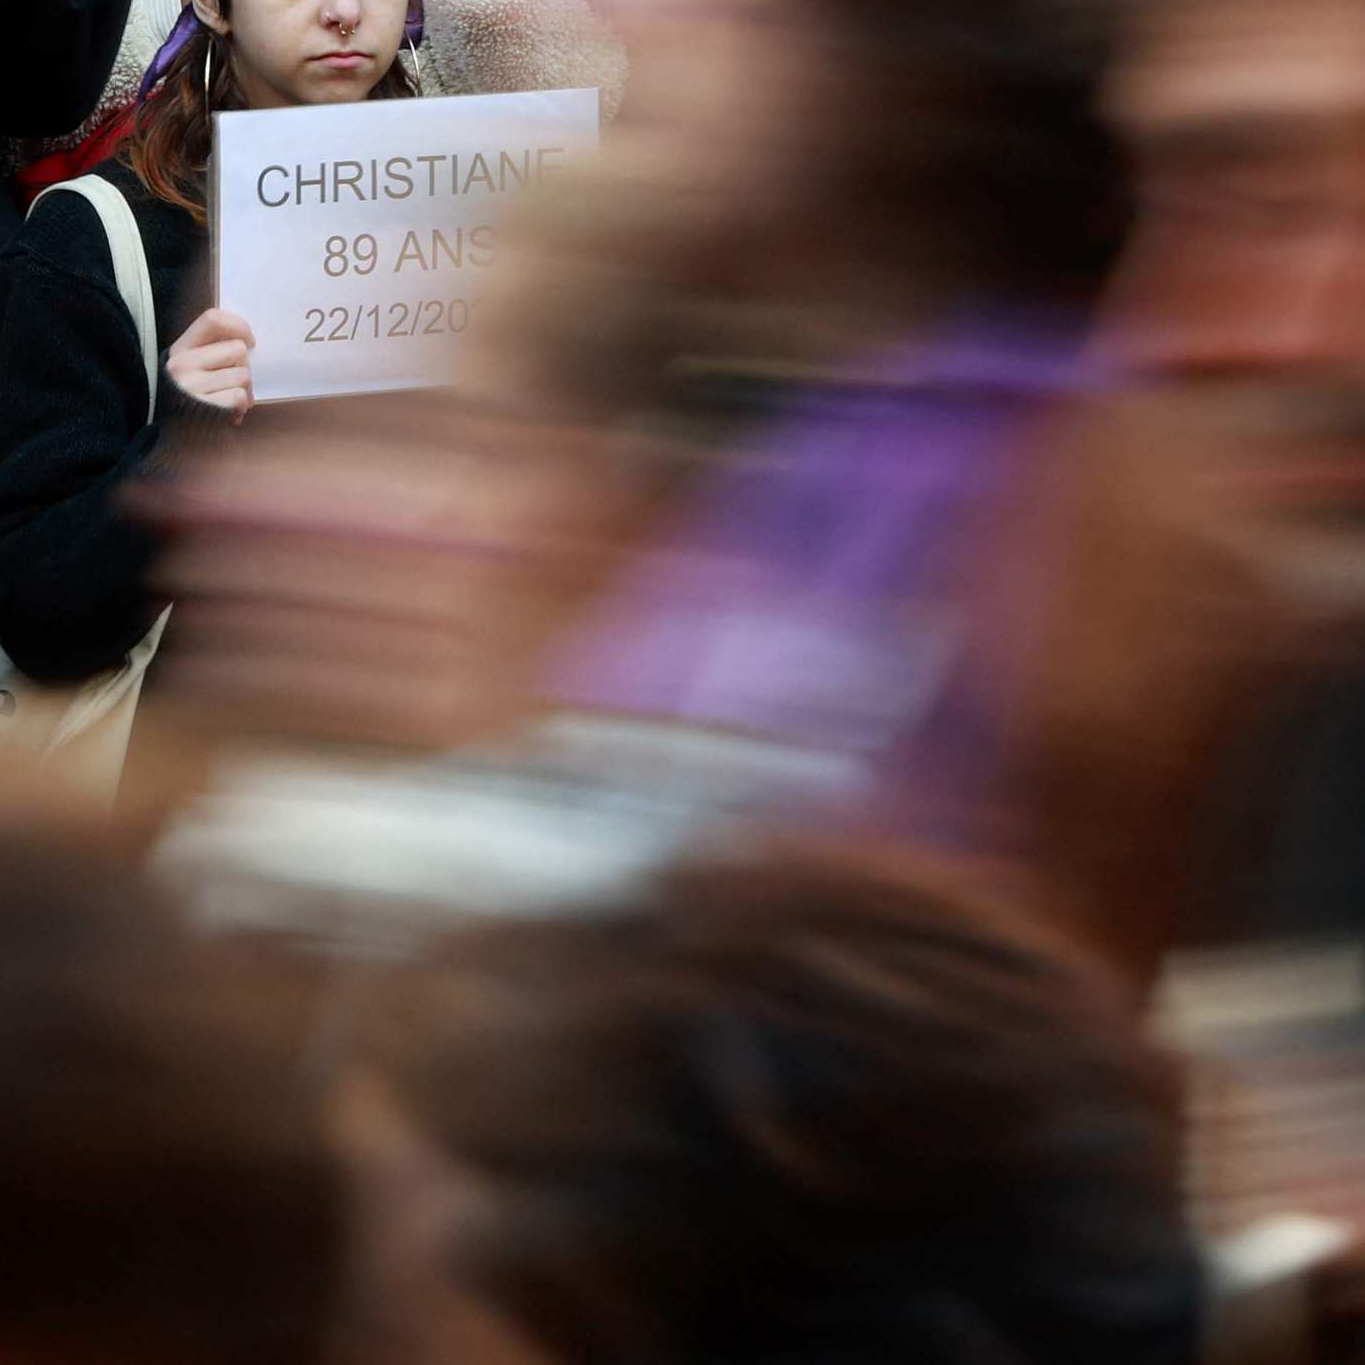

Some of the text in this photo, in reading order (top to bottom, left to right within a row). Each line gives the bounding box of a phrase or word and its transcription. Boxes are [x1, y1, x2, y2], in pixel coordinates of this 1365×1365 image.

[256, 147, 565, 207] CHRISTIANE
[323, 225, 497, 277] 89 ANS
[303, 298, 480, 343] 22/12/20
